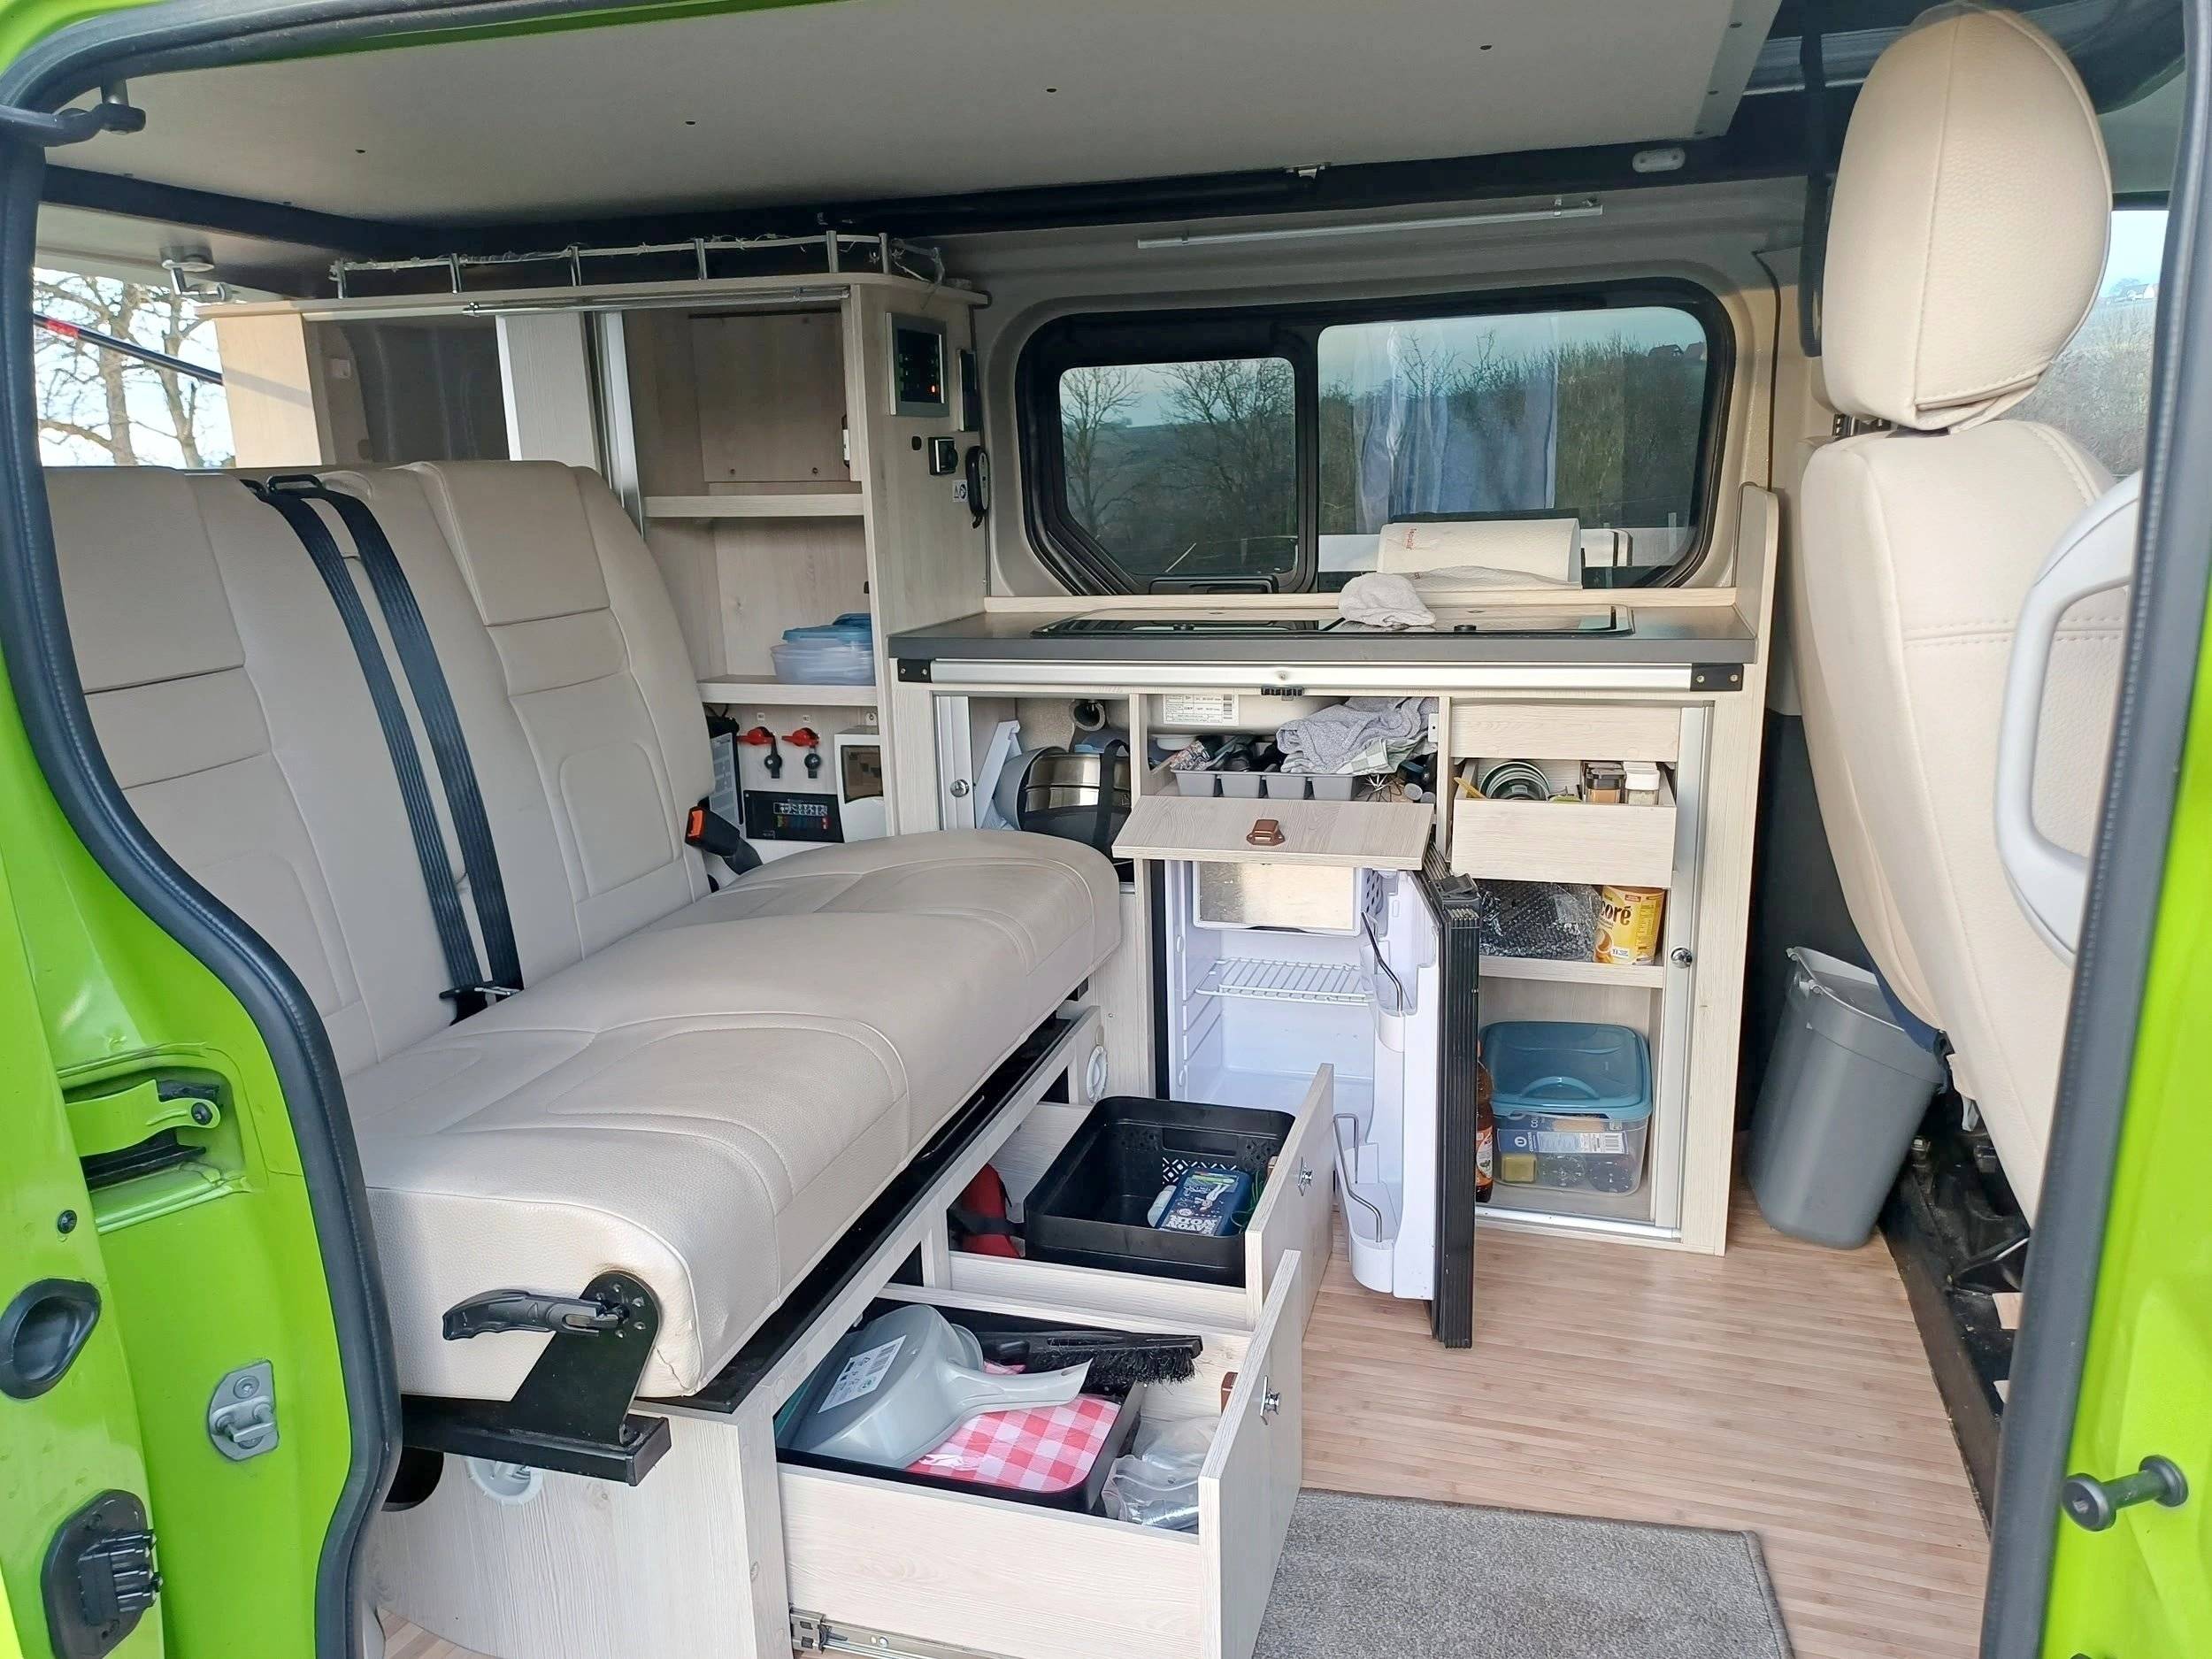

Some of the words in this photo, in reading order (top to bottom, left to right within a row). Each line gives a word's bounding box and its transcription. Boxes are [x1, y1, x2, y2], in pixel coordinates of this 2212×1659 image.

[1601, 900, 1632, 926] coré
[1170, 1215, 1217, 1226] NOIR
[1166, 1221, 1213, 1234] SAVON
